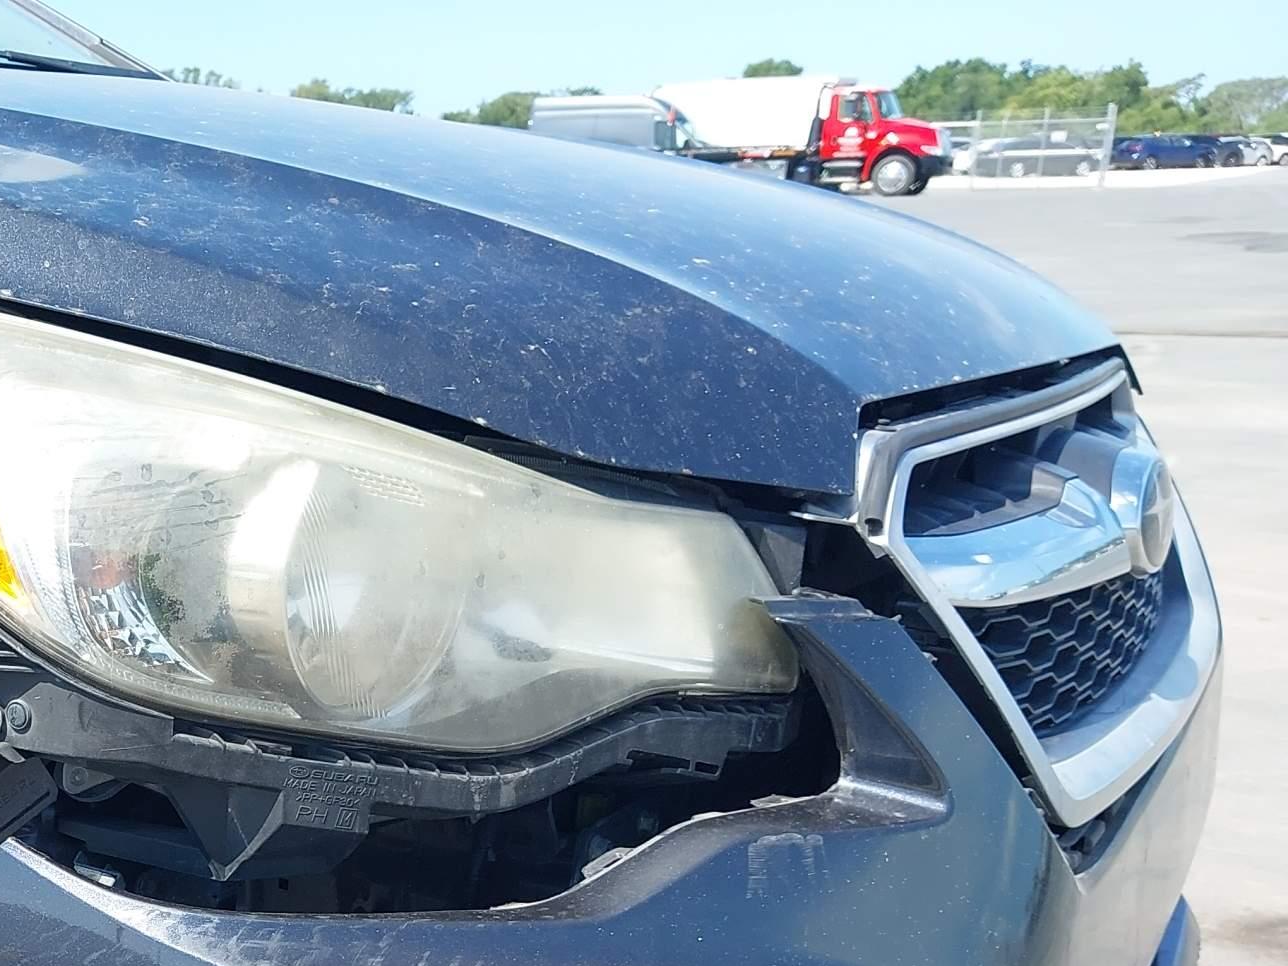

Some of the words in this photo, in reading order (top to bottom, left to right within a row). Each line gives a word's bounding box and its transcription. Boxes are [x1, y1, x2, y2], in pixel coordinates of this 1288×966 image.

[311, 769, 379, 785] SUBARU
[283, 778, 318, 792] MADE
[322, 782, 336, 794] IN
[338, 784, 377, 797] JAPAN
